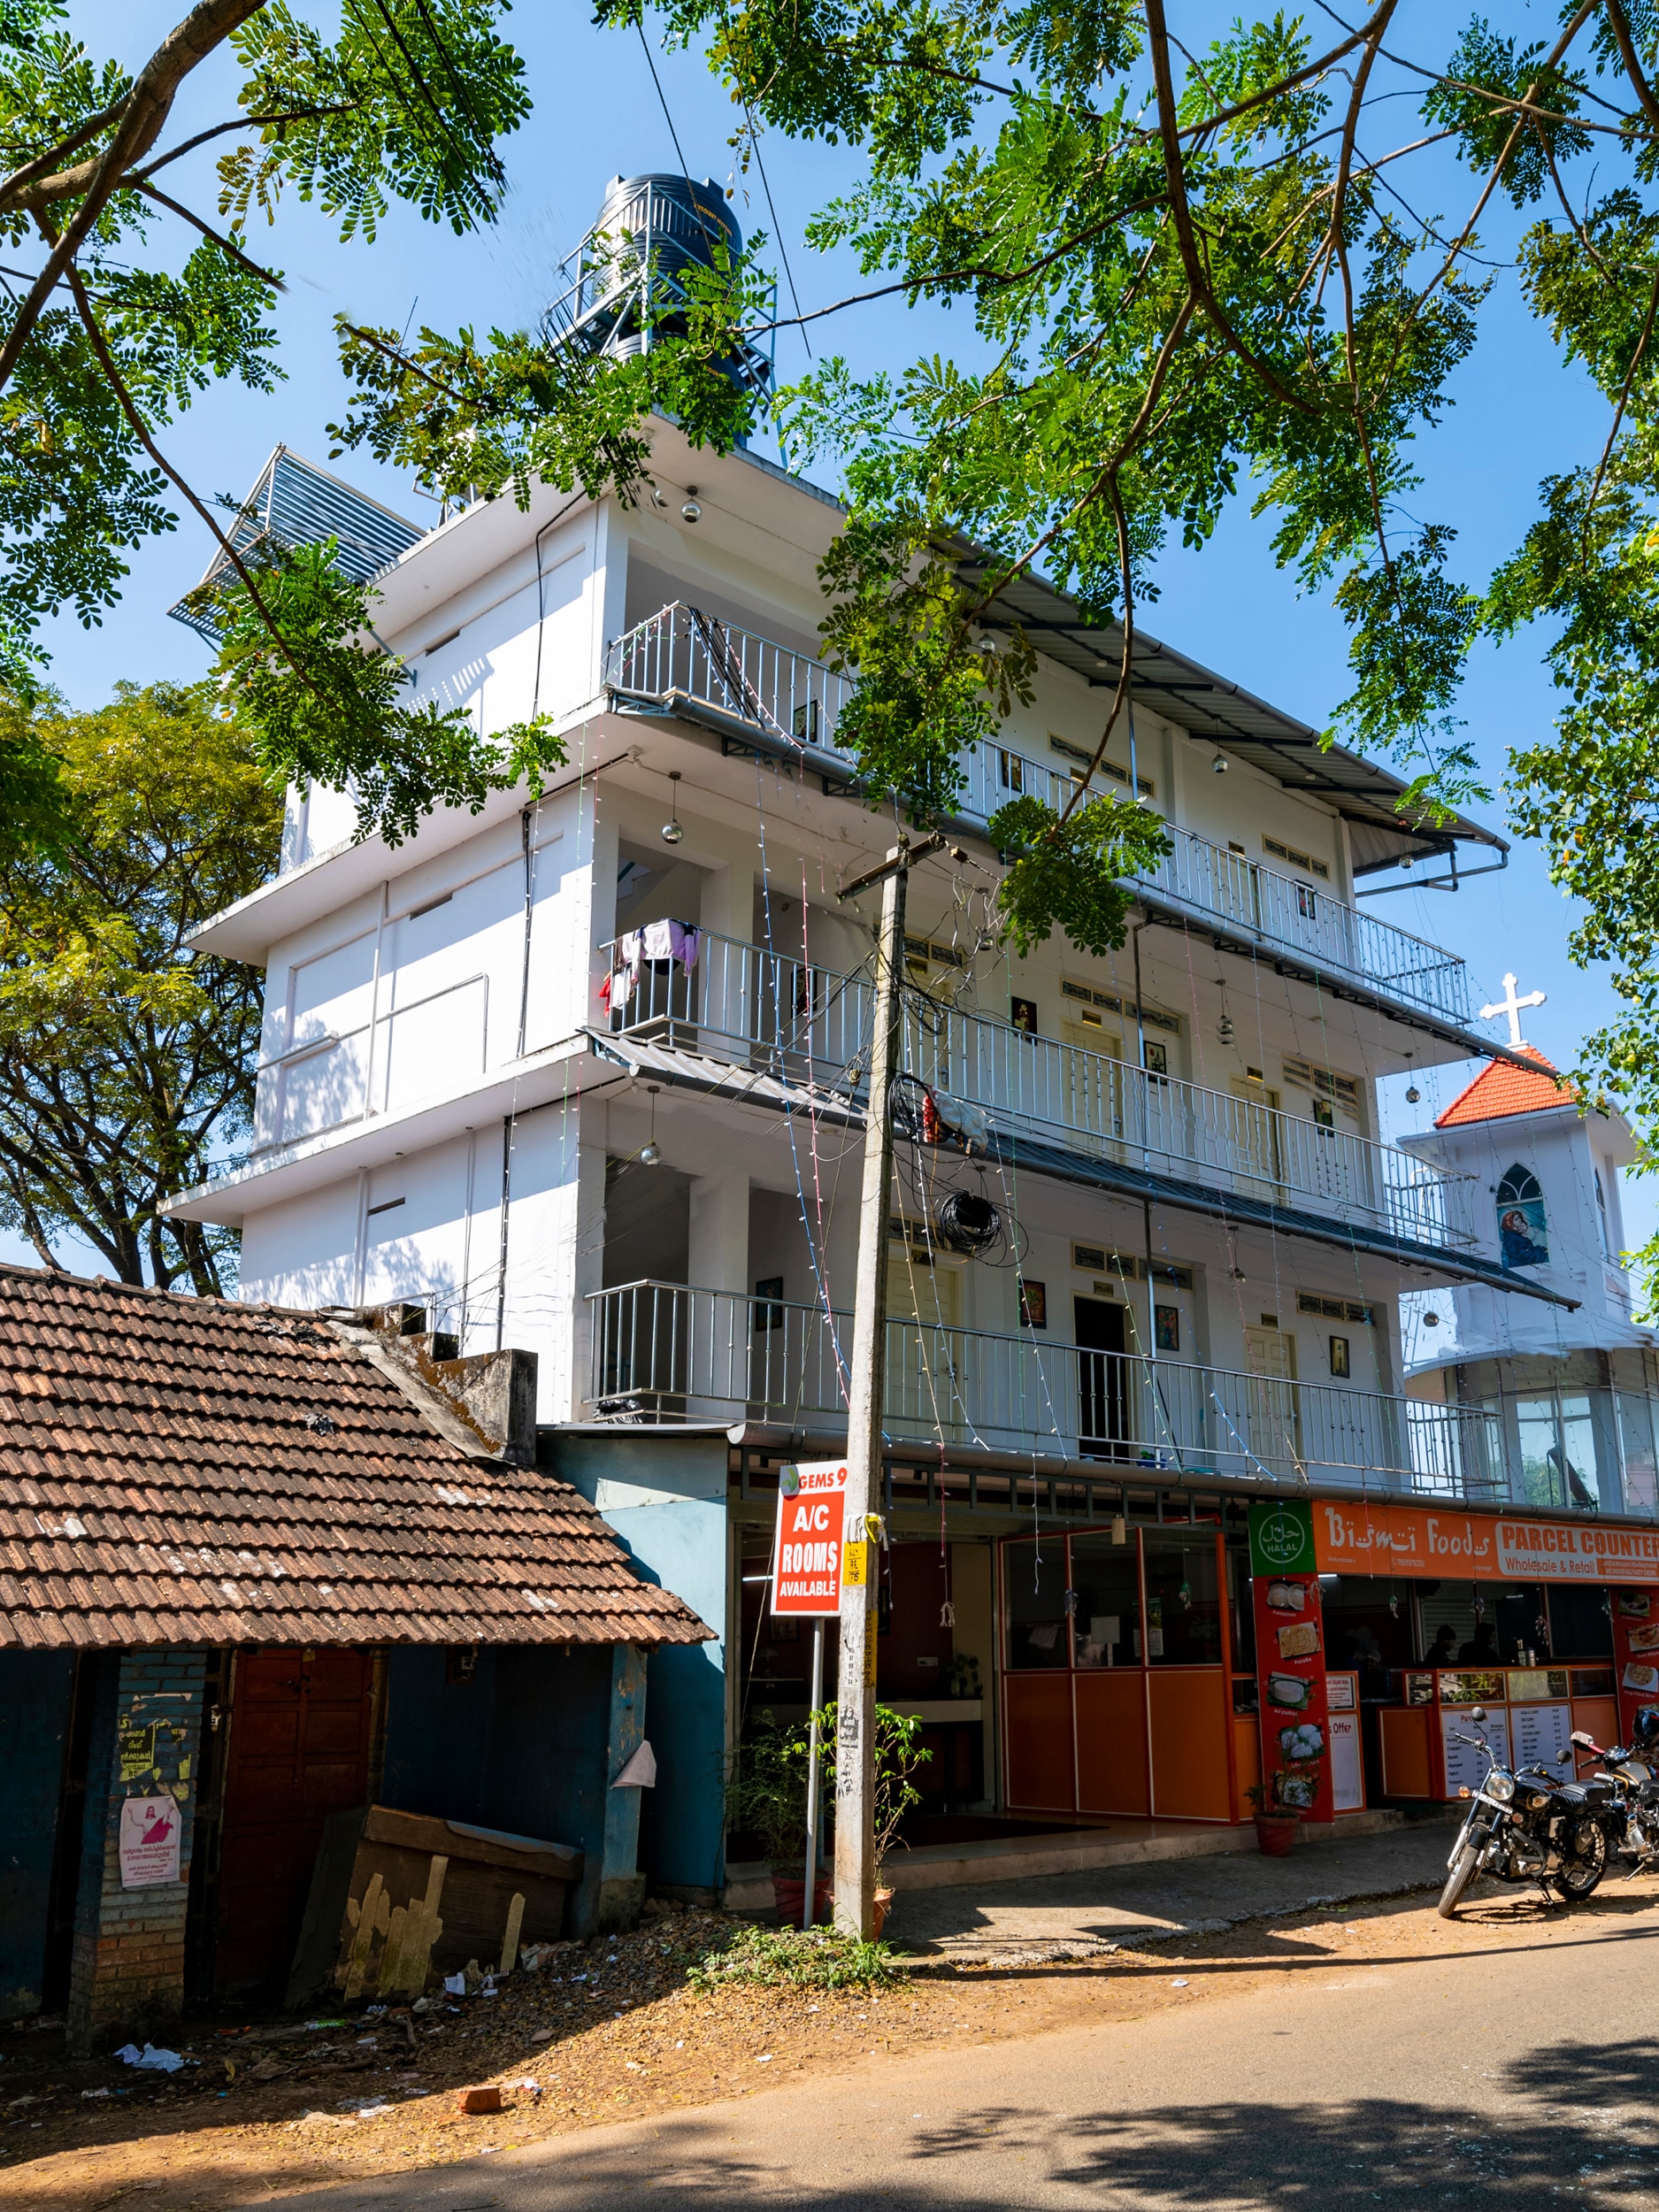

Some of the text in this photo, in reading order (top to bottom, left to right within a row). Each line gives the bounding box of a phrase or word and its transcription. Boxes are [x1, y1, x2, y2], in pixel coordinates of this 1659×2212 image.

[798, 1467, 848, 1490] GEMS 9
[792, 1504, 830, 1532] A/C
[1267, 1543, 1298, 1553] HALAL
[1426, 1517, 1490, 1556] Foods
[1502, 1525, 1578, 1554] PARCEL
[782, 1540, 838, 1573] ROOMS
[1505, 1556, 1557, 1573] Wholesale
[1560, 1560, 1567, 1572] &
[1570, 1561, 1594, 1574] Retail
[780, 1579, 836, 1596] AVAILABLE
[1333, 1723, 1352, 1734] Offer
